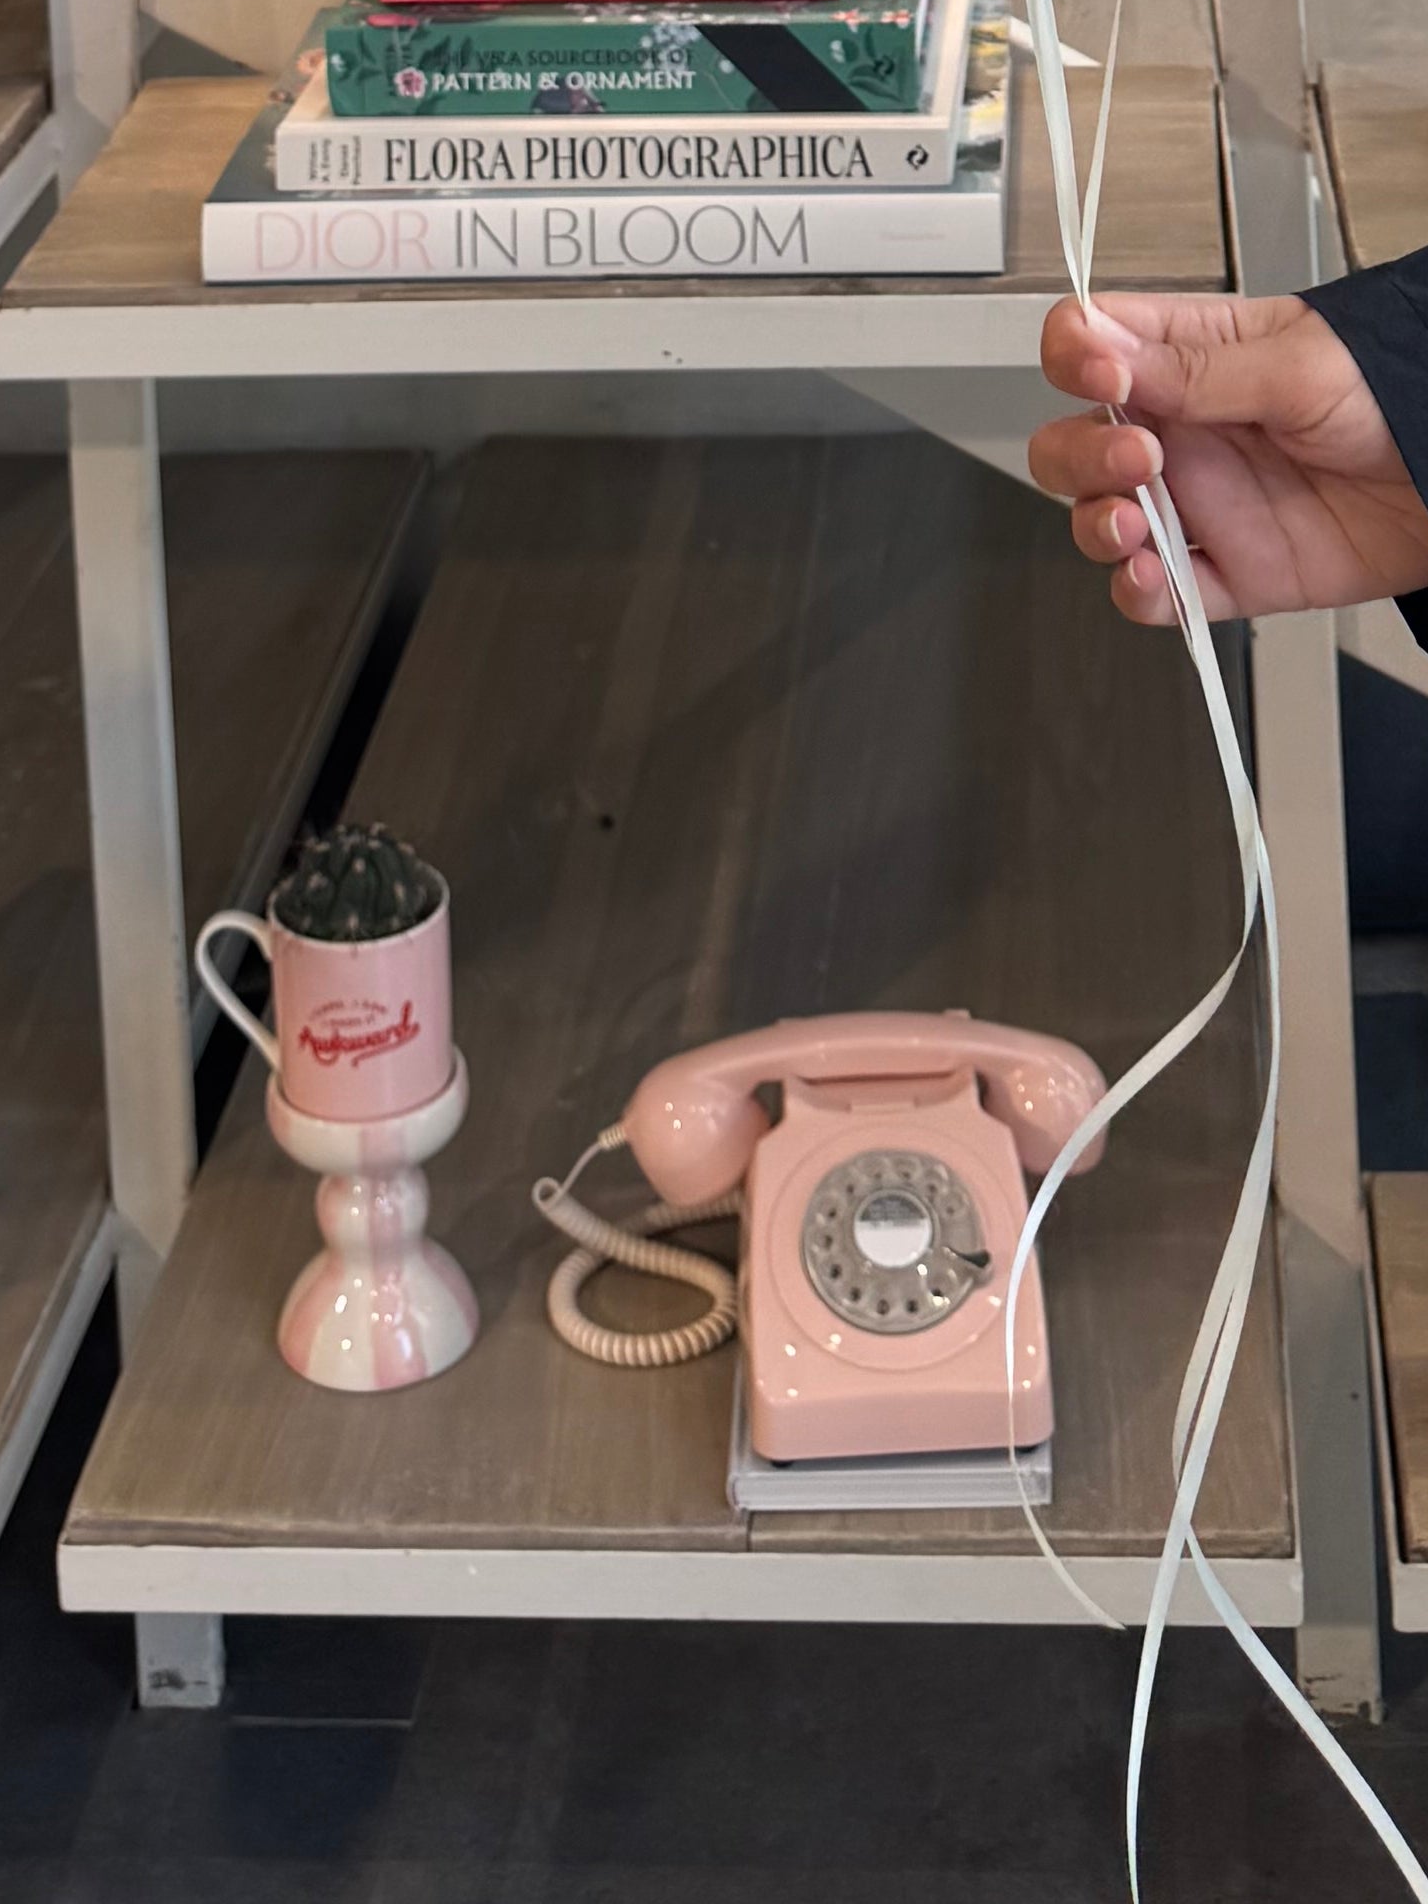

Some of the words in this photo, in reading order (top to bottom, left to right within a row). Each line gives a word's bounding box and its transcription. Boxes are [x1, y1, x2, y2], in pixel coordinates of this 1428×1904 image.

[433, 71, 533, 92] PATTERN
[538, 70, 559, 91] &
[564, 70, 697, 91] ORNAMENT
[382, 138, 515, 183] FLORA
[523, 135, 875, 181] PHOTOGRAPHICA
[255, 209, 435, 274] DIOR
[455, 207, 519, 269] IN
[543, 203, 811, 268] BLOOM
